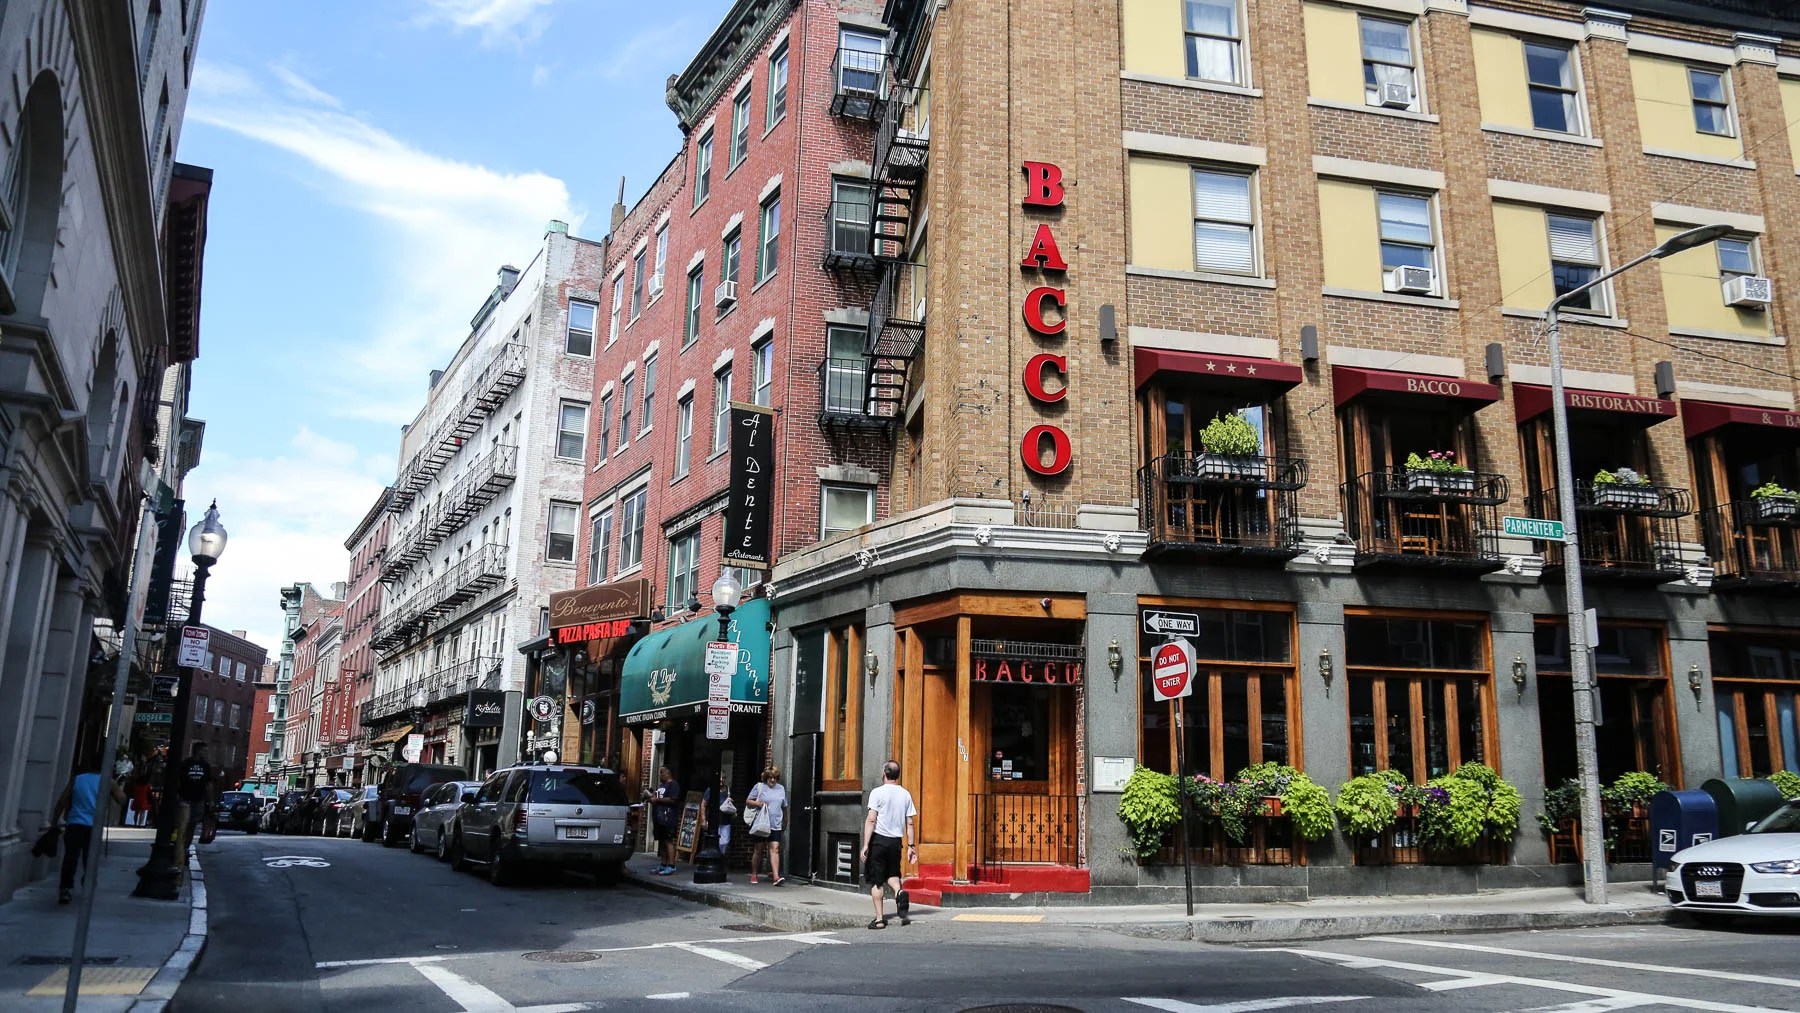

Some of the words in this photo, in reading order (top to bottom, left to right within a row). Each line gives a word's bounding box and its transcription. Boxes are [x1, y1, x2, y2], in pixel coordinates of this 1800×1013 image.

[1022, 160, 1072, 475] BACCO
[1407, 378, 1460, 395] BACCO
[1570, 393, 1664, 414] RISTORANTE
[1762, 412, 1773, 424] &
[1505, 518, 1555, 537] PARMENTER
[1555, 529, 1562, 537] ST
[728, 549, 764, 560] Ristorante
[551, 591, 639, 618] Benevento's
[558, 626, 582, 644] PIZZA
[583, 621, 611, 641] PASTA
[1158, 619, 1172, 628] ONE
[1176, 620, 1192, 629] WAY
[1159, 657, 1167, 665] DO
[1168, 653, 1180, 663] NOT
[975, 659, 1077, 685] BACCO
[1162, 676, 1180, 688] ENTER
[729, 703, 762, 714] TORANTE
